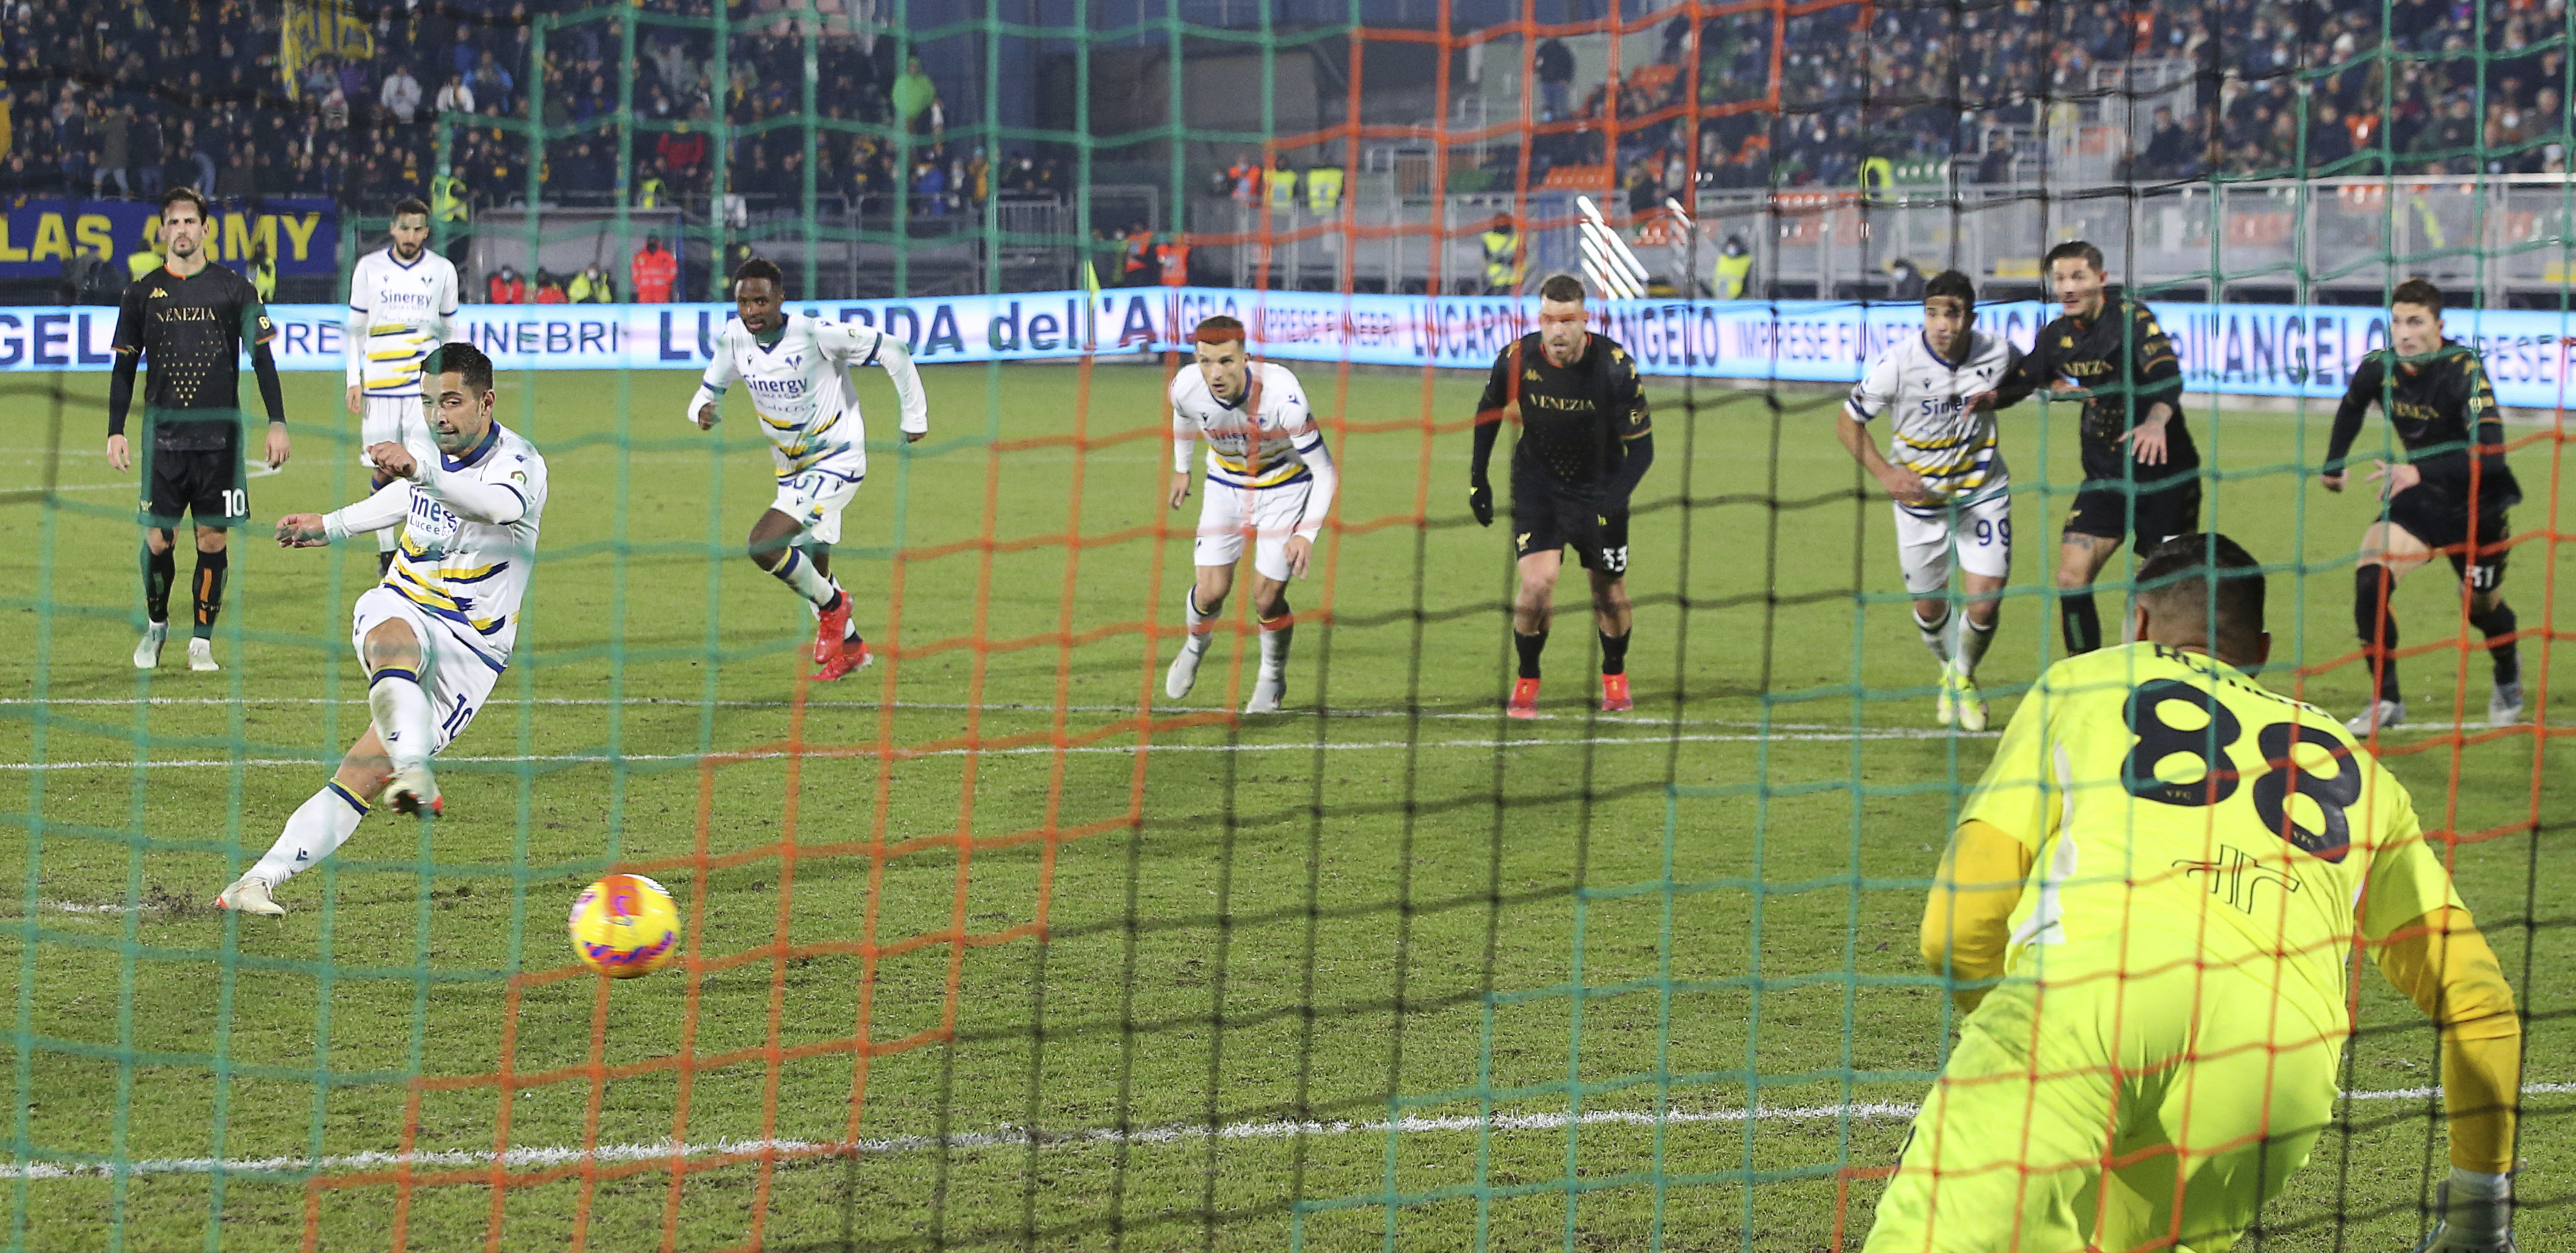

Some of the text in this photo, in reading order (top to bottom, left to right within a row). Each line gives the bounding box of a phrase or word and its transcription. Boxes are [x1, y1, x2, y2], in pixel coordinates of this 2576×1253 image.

[380, 289, 432, 308] Sinergy
[156, 307, 216, 322] VENEZIA
[743, 374, 808, 393] Sinergy
[1529, 393, 1596, 412] VENEZIA
[222, 488, 246, 518] 10
[1976, 518, 2011, 547] 99
[442, 692, 474, 742] 10
[2120, 678, 2361, 864] 88
